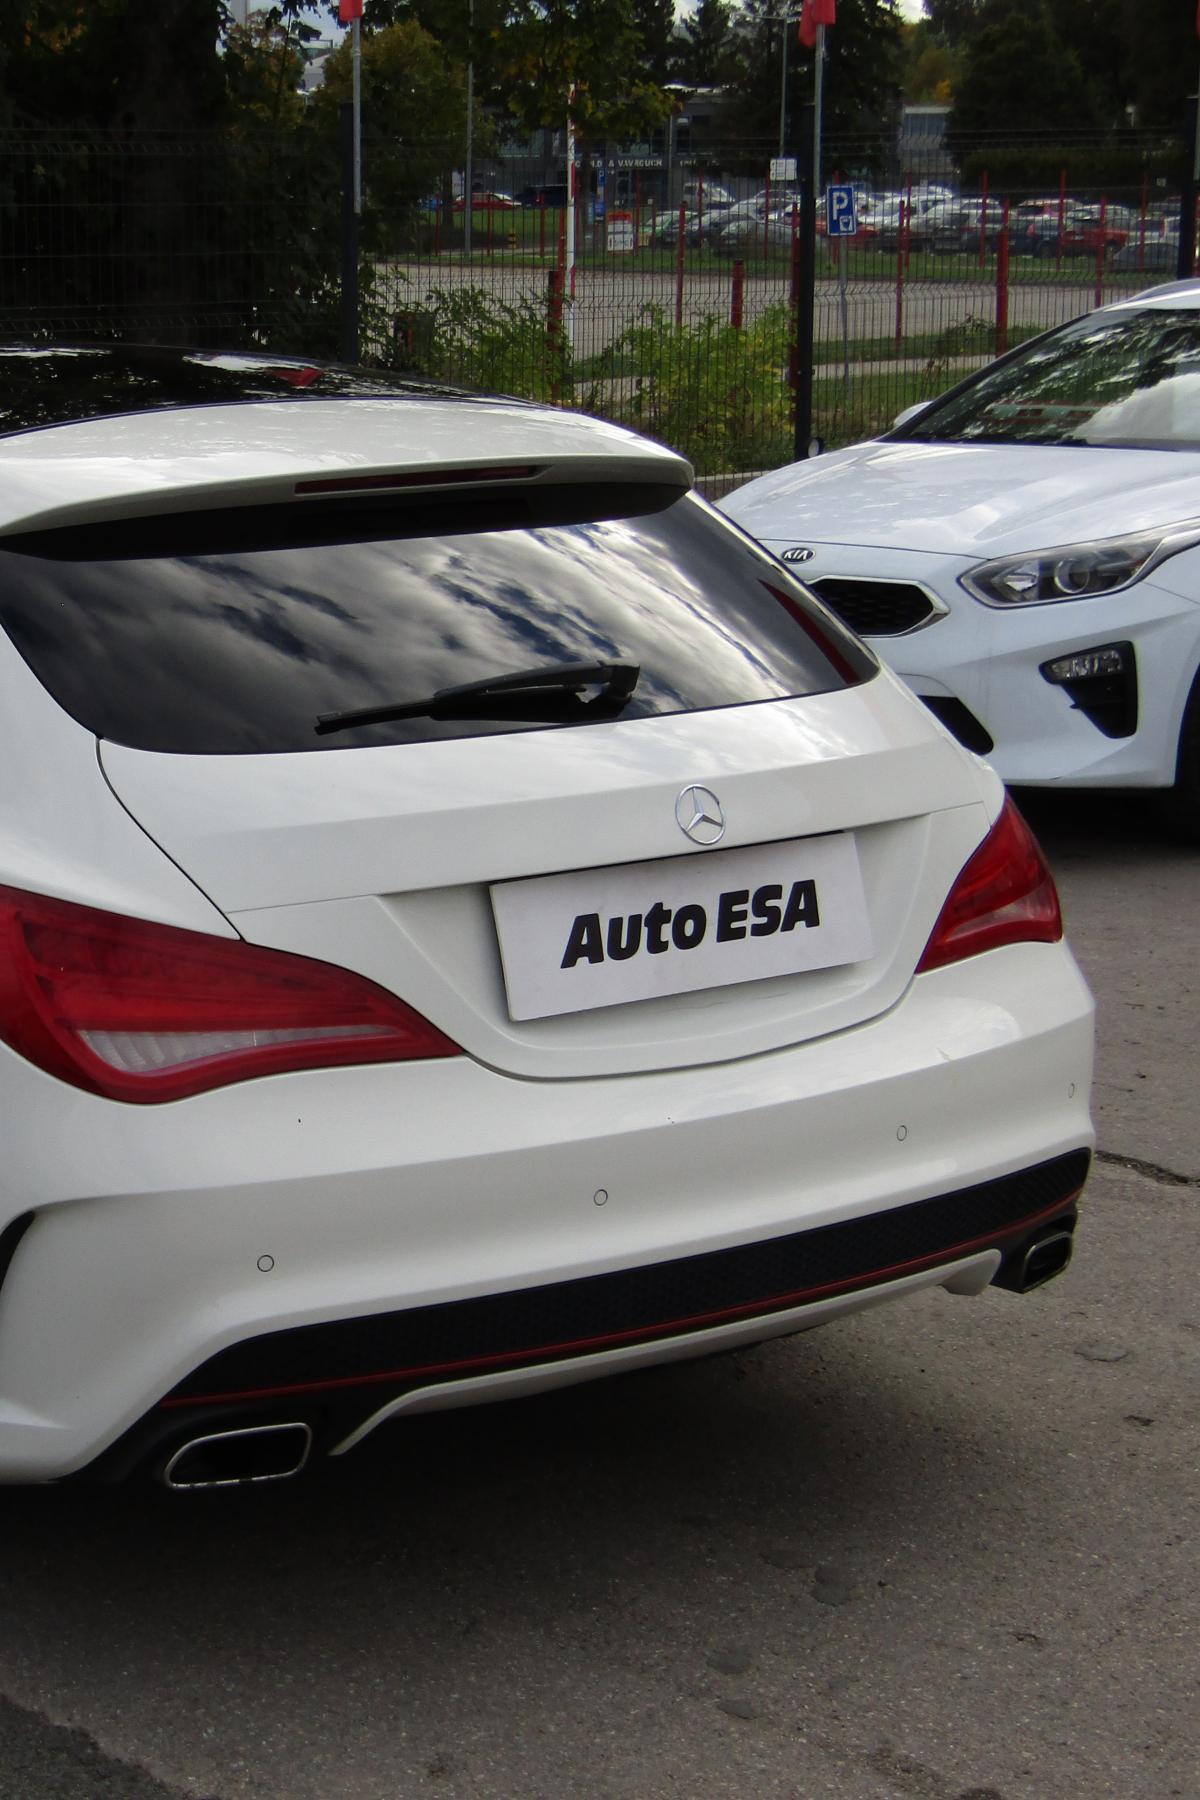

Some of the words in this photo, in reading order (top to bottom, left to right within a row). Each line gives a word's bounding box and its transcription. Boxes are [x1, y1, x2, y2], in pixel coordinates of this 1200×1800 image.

[832, 191, 849, 220] P
[783, 549, 809, 560] KIA
[560, 901, 707, 969] Auto
[716, 879, 820, 943] ESA
